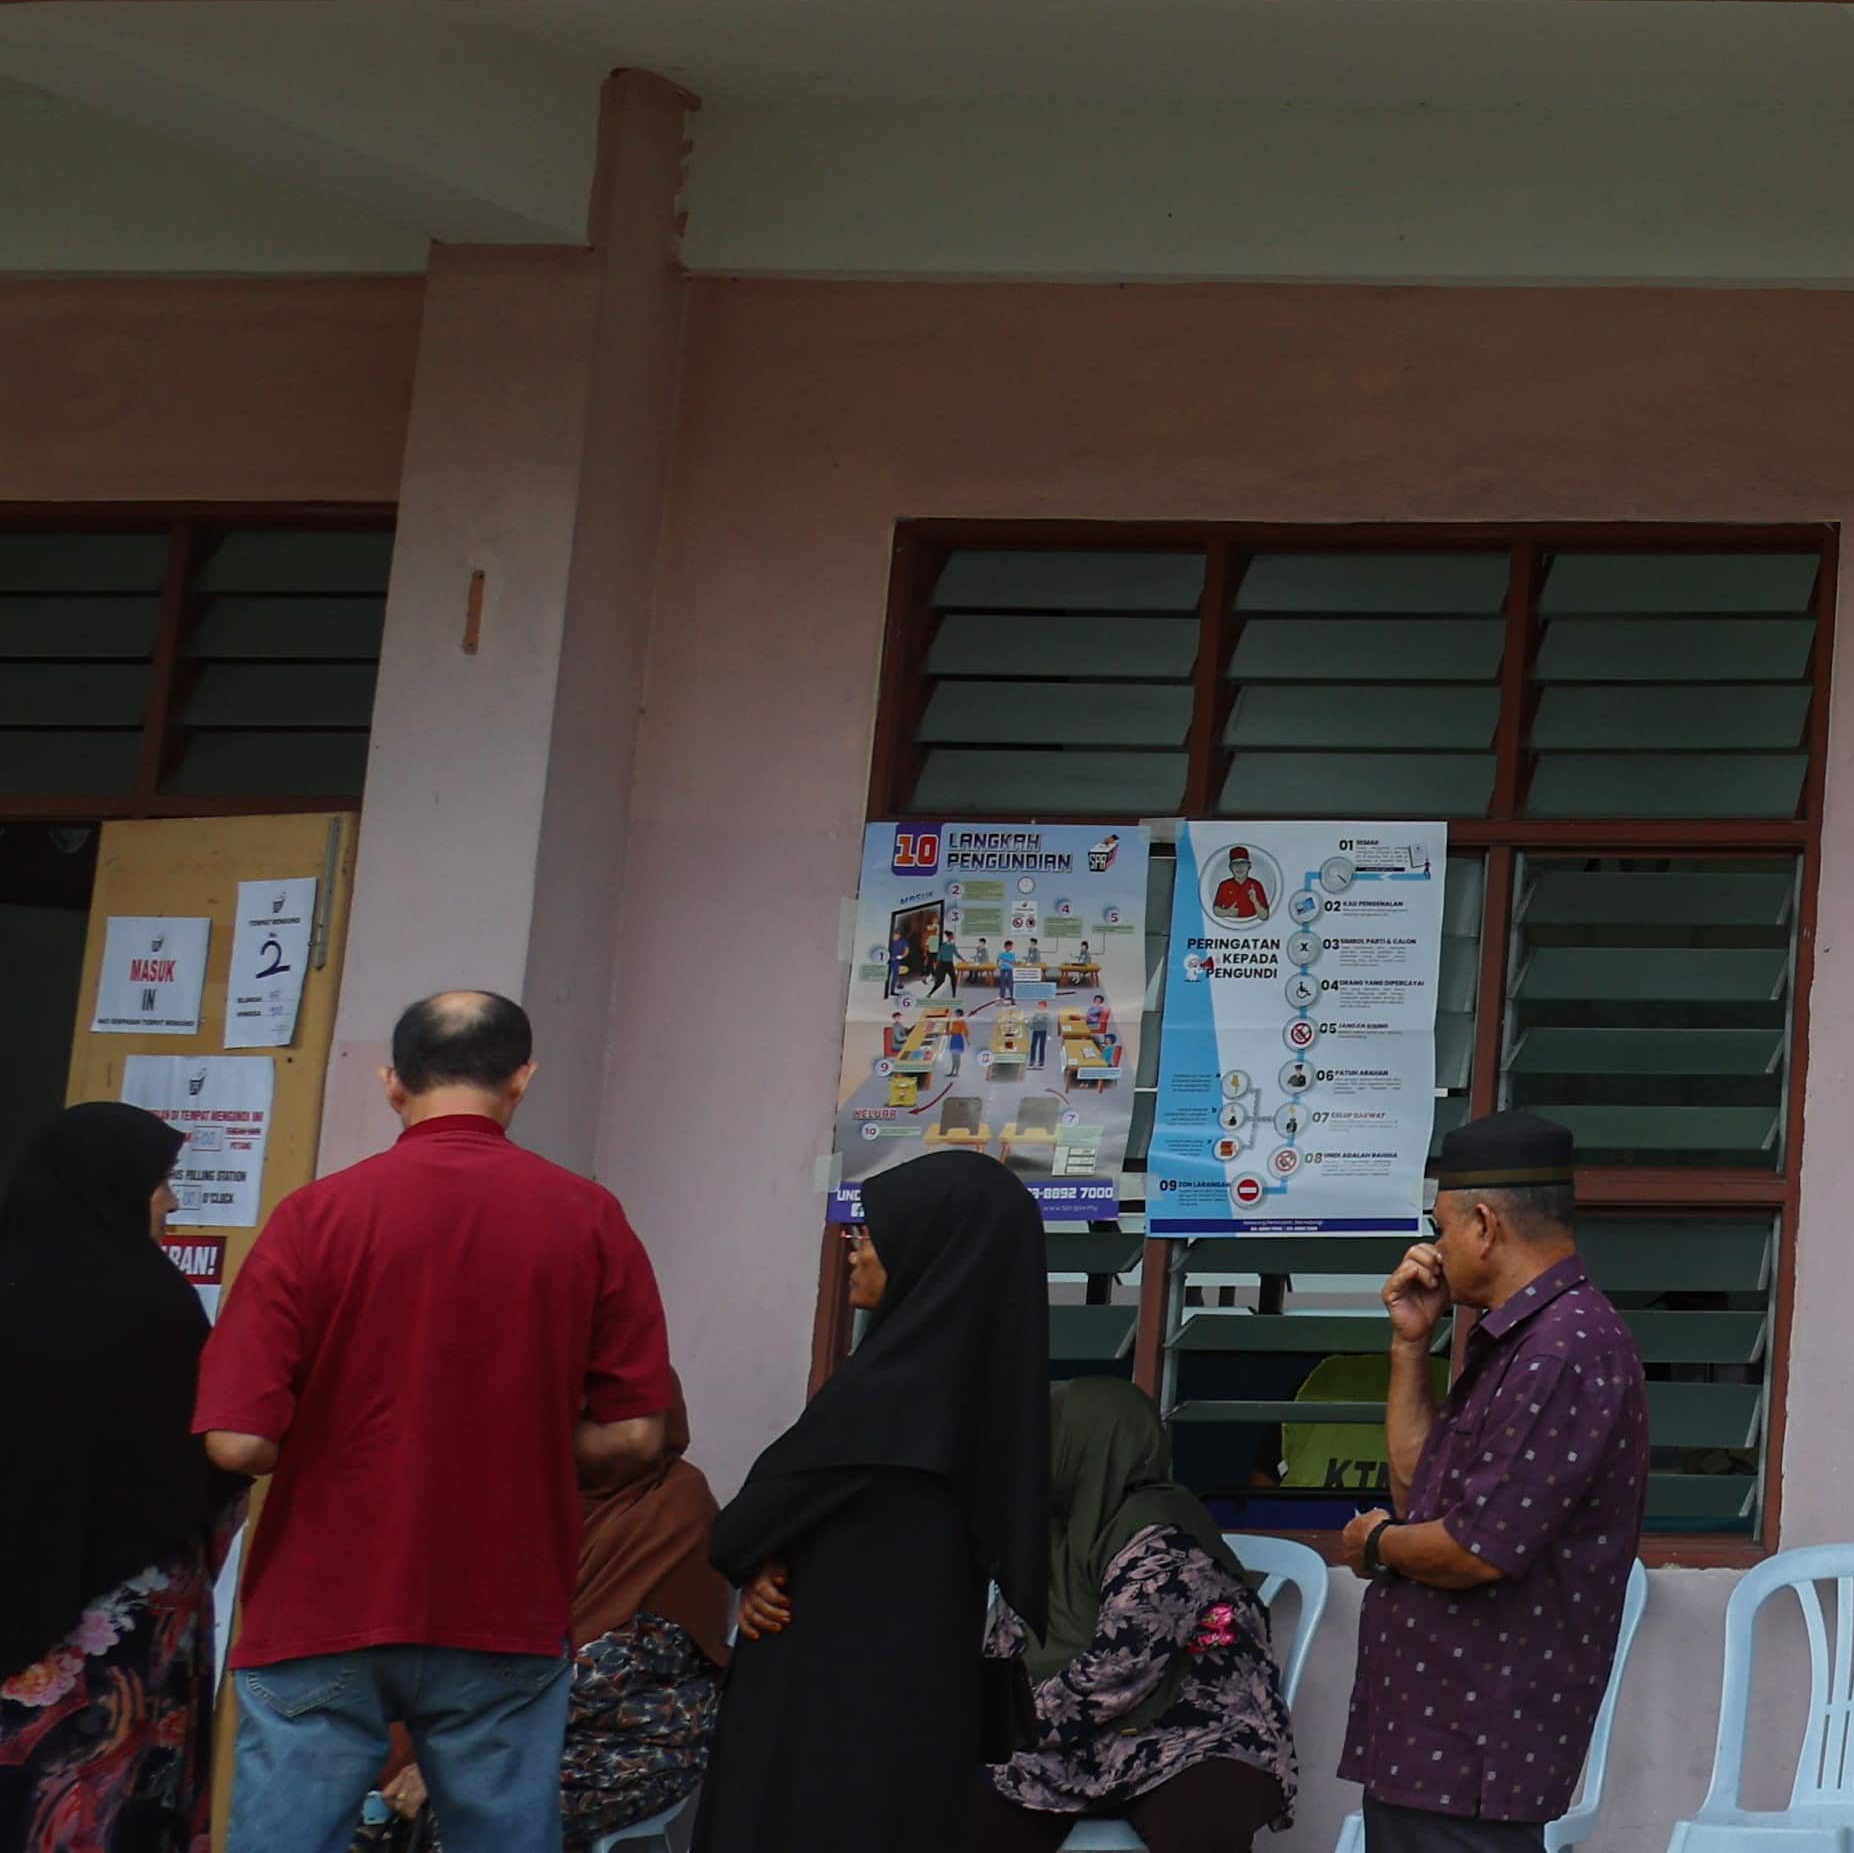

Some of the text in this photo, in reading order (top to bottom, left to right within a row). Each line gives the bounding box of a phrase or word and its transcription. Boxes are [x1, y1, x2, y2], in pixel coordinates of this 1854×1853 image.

[949, 833, 1041, 852] LANGKAH
[1339, 840, 1354, 850] 01
[895, 834, 938, 867] 10
[947, 853, 1073, 873] PENGUNDIAN
[1089, 853, 1106, 871] SPR
[951, 886, 960, 895] 2
[1062, 904, 1070, 914] 4
[1324, 901, 1341, 911] 02
[951, 912, 959, 921] 3
[1111, 913, 1118, 922] 5
[1187, 938, 1280, 949] PERINGATAN
[1323, 939, 1339, 950] 03
[256, 940, 290, 979] 2
[1223, 954, 1278, 964] KEPADA
[130, 959, 176, 982] MASUK
[1206, 968, 1277, 978] PENGUNDI
[1321, 980, 1339, 991] 04
[141, 989, 157, 1011] IN
[902, 998, 910, 1007] 6
[1319, 1023, 1337, 1034] 05
[881, 1063, 889, 1072] 9
[1316, 1070, 1334, 1081] 06
[1312, 1112, 1329, 1122] 07
[864, 1127, 876, 1135] 10
[1305, 1153, 1322, 1163] 08
[184, 1170, 215, 1181] POLLING
[216, 1171, 247, 1182] STATION
[1160, 1180, 1177, 1191] 09
[1080, 1188, 1113, 1199] 7000
